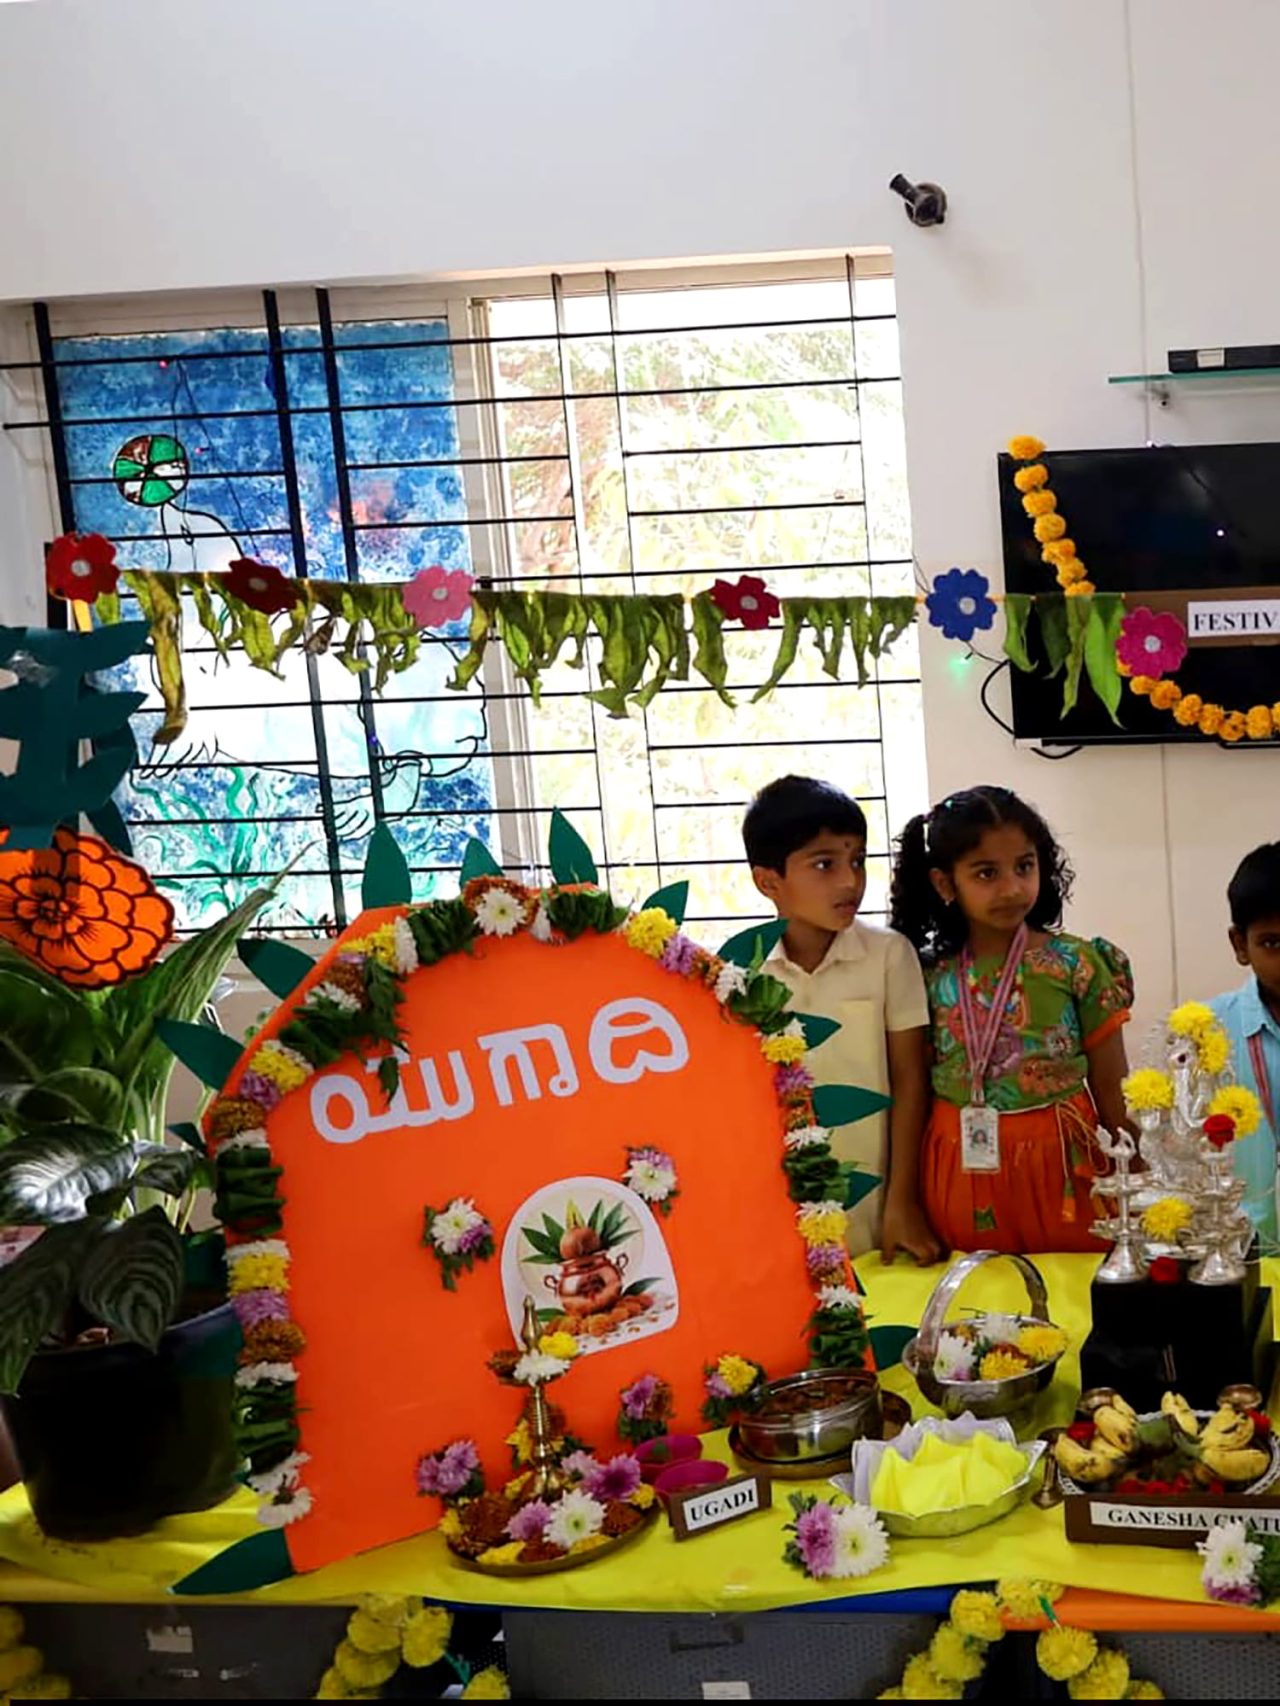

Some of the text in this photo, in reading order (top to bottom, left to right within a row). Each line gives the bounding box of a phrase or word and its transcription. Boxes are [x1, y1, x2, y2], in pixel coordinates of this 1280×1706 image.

[310, 997, 689, 1143] ಯುಗಾದಿ
[690, 1489, 754, 1521] UGADI
[1108, 1509, 1208, 1528] GANESHA
